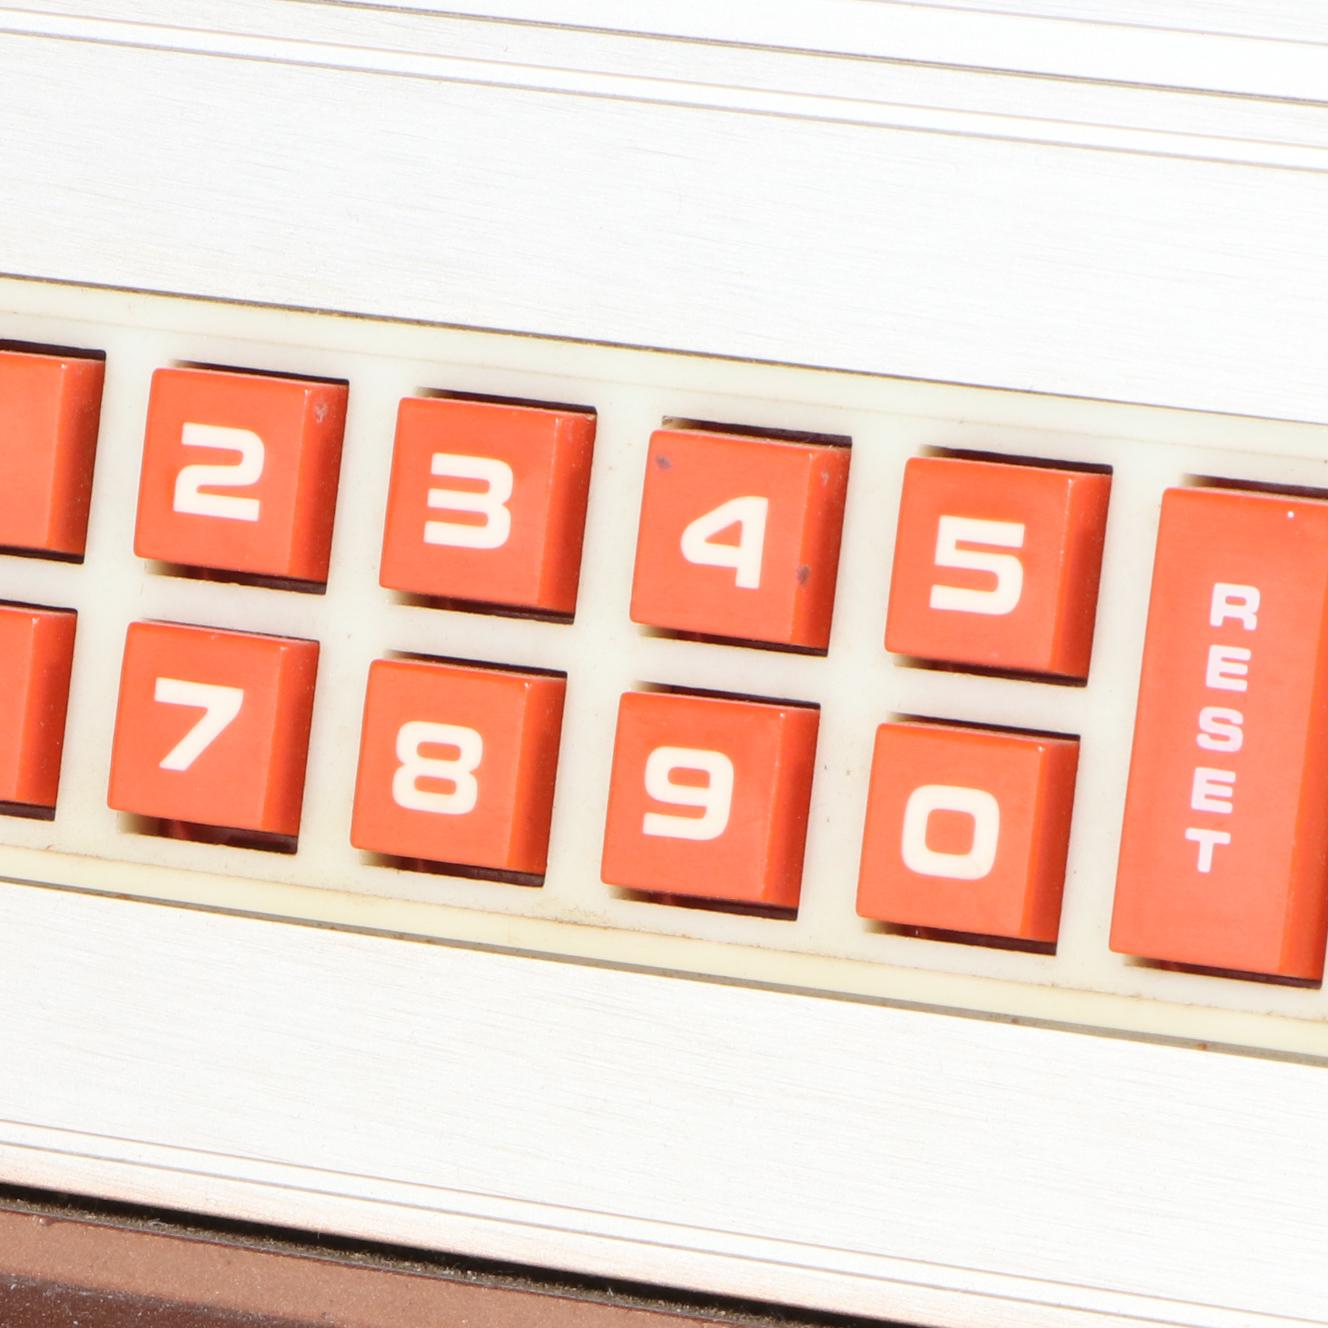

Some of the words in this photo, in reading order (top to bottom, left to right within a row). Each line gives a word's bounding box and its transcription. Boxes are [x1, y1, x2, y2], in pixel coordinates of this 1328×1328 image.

[172, 421, 266, 523] 2
[422, 451, 515, 551] 3
[679, 494, 769, 591] 4
[929, 513, 1026, 617] 5
[151, 677, 244, 773] 7
[391, 718, 485, 816] 8
[1183, 581, 1262, 876] RESET
[640, 745, 735, 842] 9
[900, 784, 1001, 882] 0
